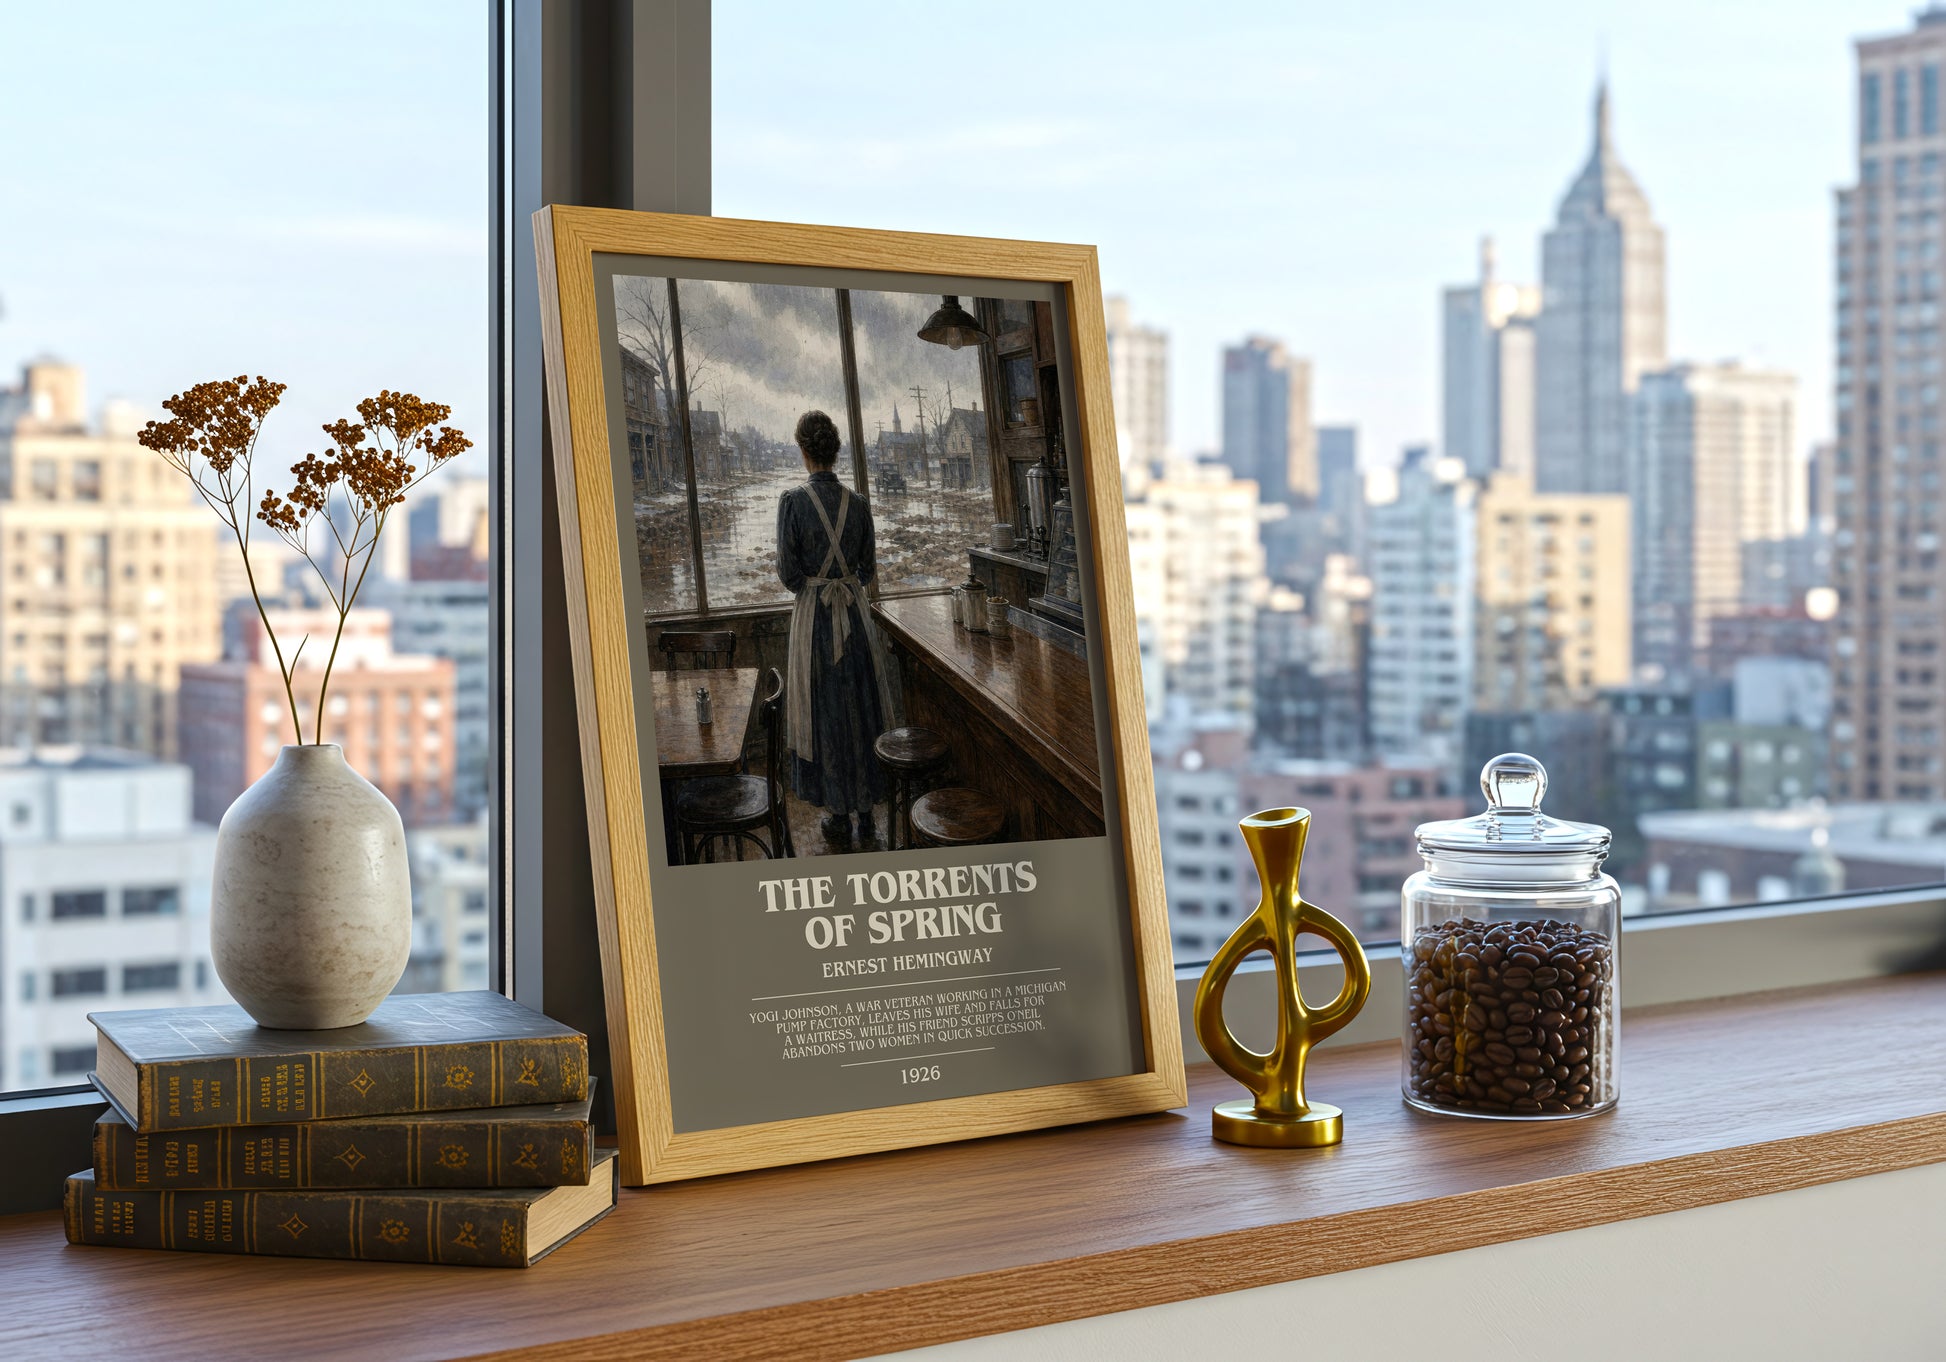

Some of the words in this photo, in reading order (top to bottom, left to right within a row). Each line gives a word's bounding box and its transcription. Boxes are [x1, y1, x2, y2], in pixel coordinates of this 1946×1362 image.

[758, 875, 836, 913] THE
[846, 861, 1037, 906] TORRENTS
[805, 914, 856, 949] OF
[868, 902, 1003, 944] SPRING
[822, 957, 888, 978] ERNEST
[892, 947, 993, 971] HEMINGWAY
[749, 1010, 779, 1024] YOGI
[782, 1004, 842, 1021] JOHNSON,
[845, 1003, 853, 1014] A
[856, 1000, 882, 1013] WAR
[884, 994, 933, 1009] VETERAN
[936, 989, 988, 1004] WORKING
[991, 987, 1002, 998] IN
[1005, 986, 1012, 997] A
[1015, 980, 1066, 996] MICHIGAN
[776, 1020, 807, 1034] PUMP
[810, 1014, 865, 1031] FACTORY,
[868, 1009, 911, 1024] LEAVES
[913, 1007, 932, 1019] HIS
[935, 1004, 961, 1017] WIFE
[964, 1001, 986, 1014] AND
[989, 998, 1021, 1011] FALLS
[1023, 995, 1045, 1007] FOR
[782, 1042, 846, 1060] ABANDONS
[848, 1039, 875, 1052] TWO
[878, 1033, 920, 1048] WOMEN
[923, 1032, 935, 1043] IN
[938, 1028, 973, 1042] QUICK
[975, 1019, 1045, 1037] SUCCESSION.
[784, 1035, 793, 1046] A
[795, 1028, 856, 1045] WAITRESS,
[859, 1024, 895, 1038] WHILE
[897, 1021, 916, 1033] HIS
[919, 1017, 958, 1031] FRIEND
[961, 1012, 1004, 1026] SCRIPPS
[901, 1065, 941, 1084] 1926
